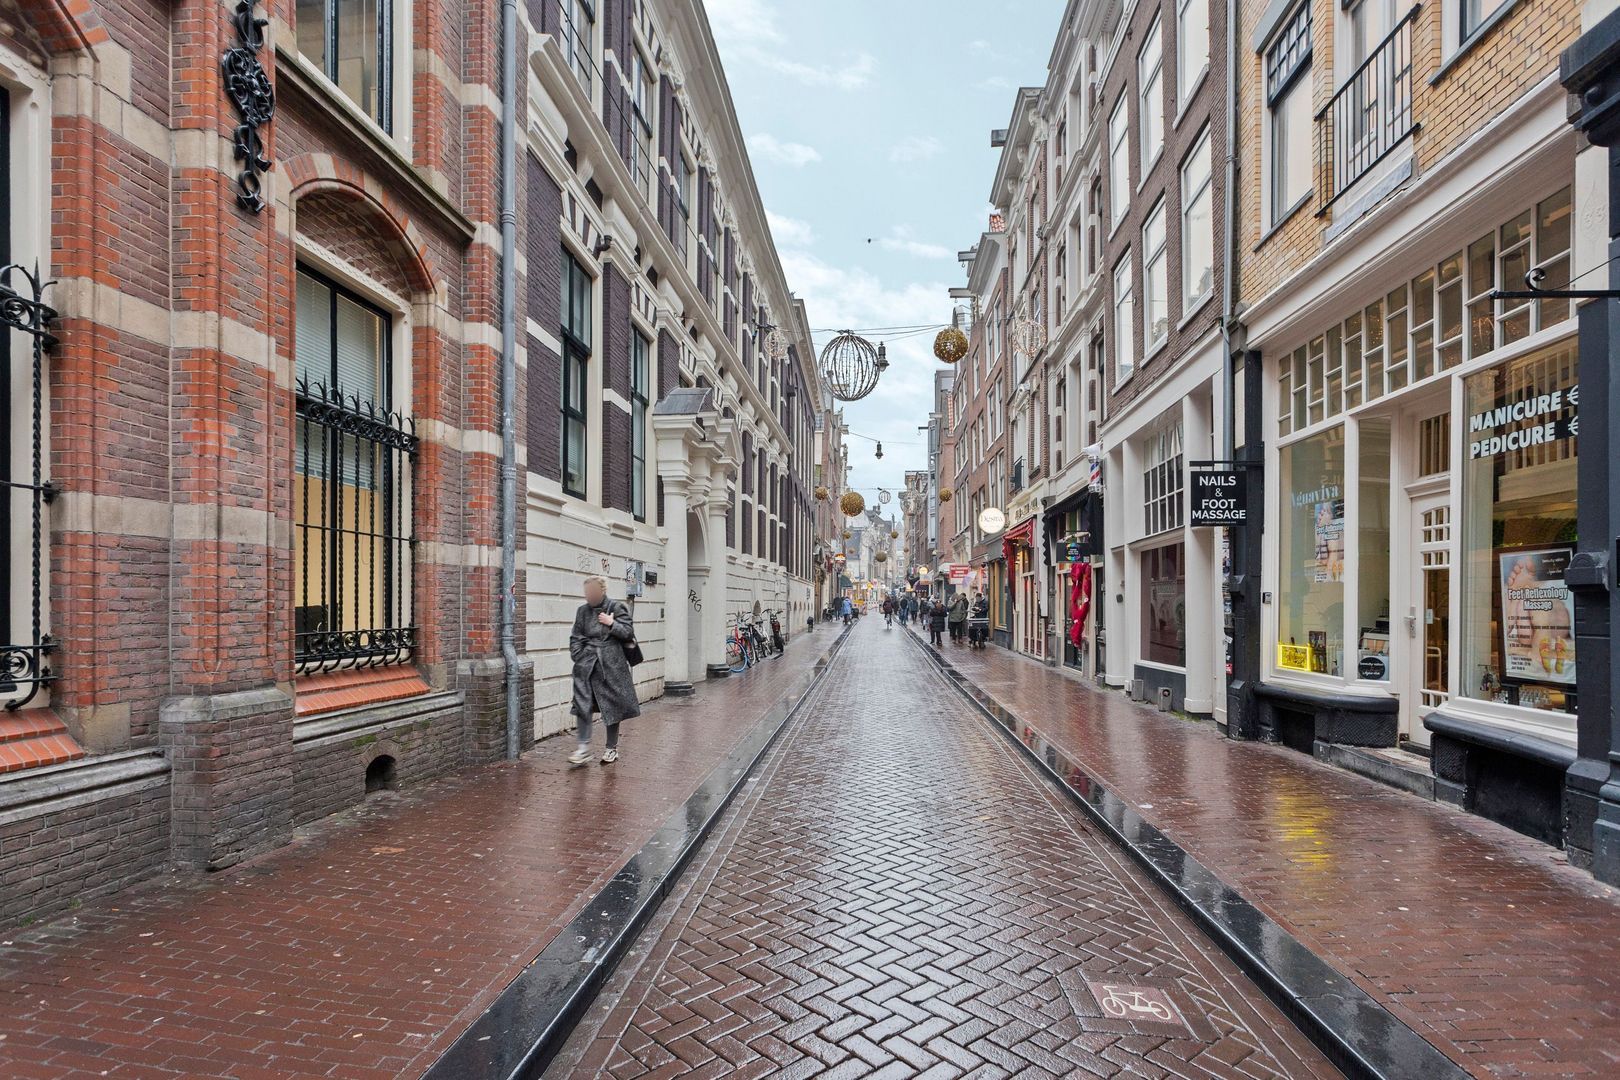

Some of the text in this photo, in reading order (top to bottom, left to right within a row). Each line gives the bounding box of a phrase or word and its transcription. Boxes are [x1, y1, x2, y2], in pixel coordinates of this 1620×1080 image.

[1470, 391, 1562, 433] MANICURE
[1470, 422, 1556, 460] PEDICURE
[1199, 475, 1237, 486] NAILS
[1214, 487, 1223, 497] &
[1201, 498, 1237, 509] FOOT
[1192, 509, 1246, 519] MASSAGE
[1508, 587, 1569, 600] Feet Reflexology
[1523, 600, 1553, 611] Massage
